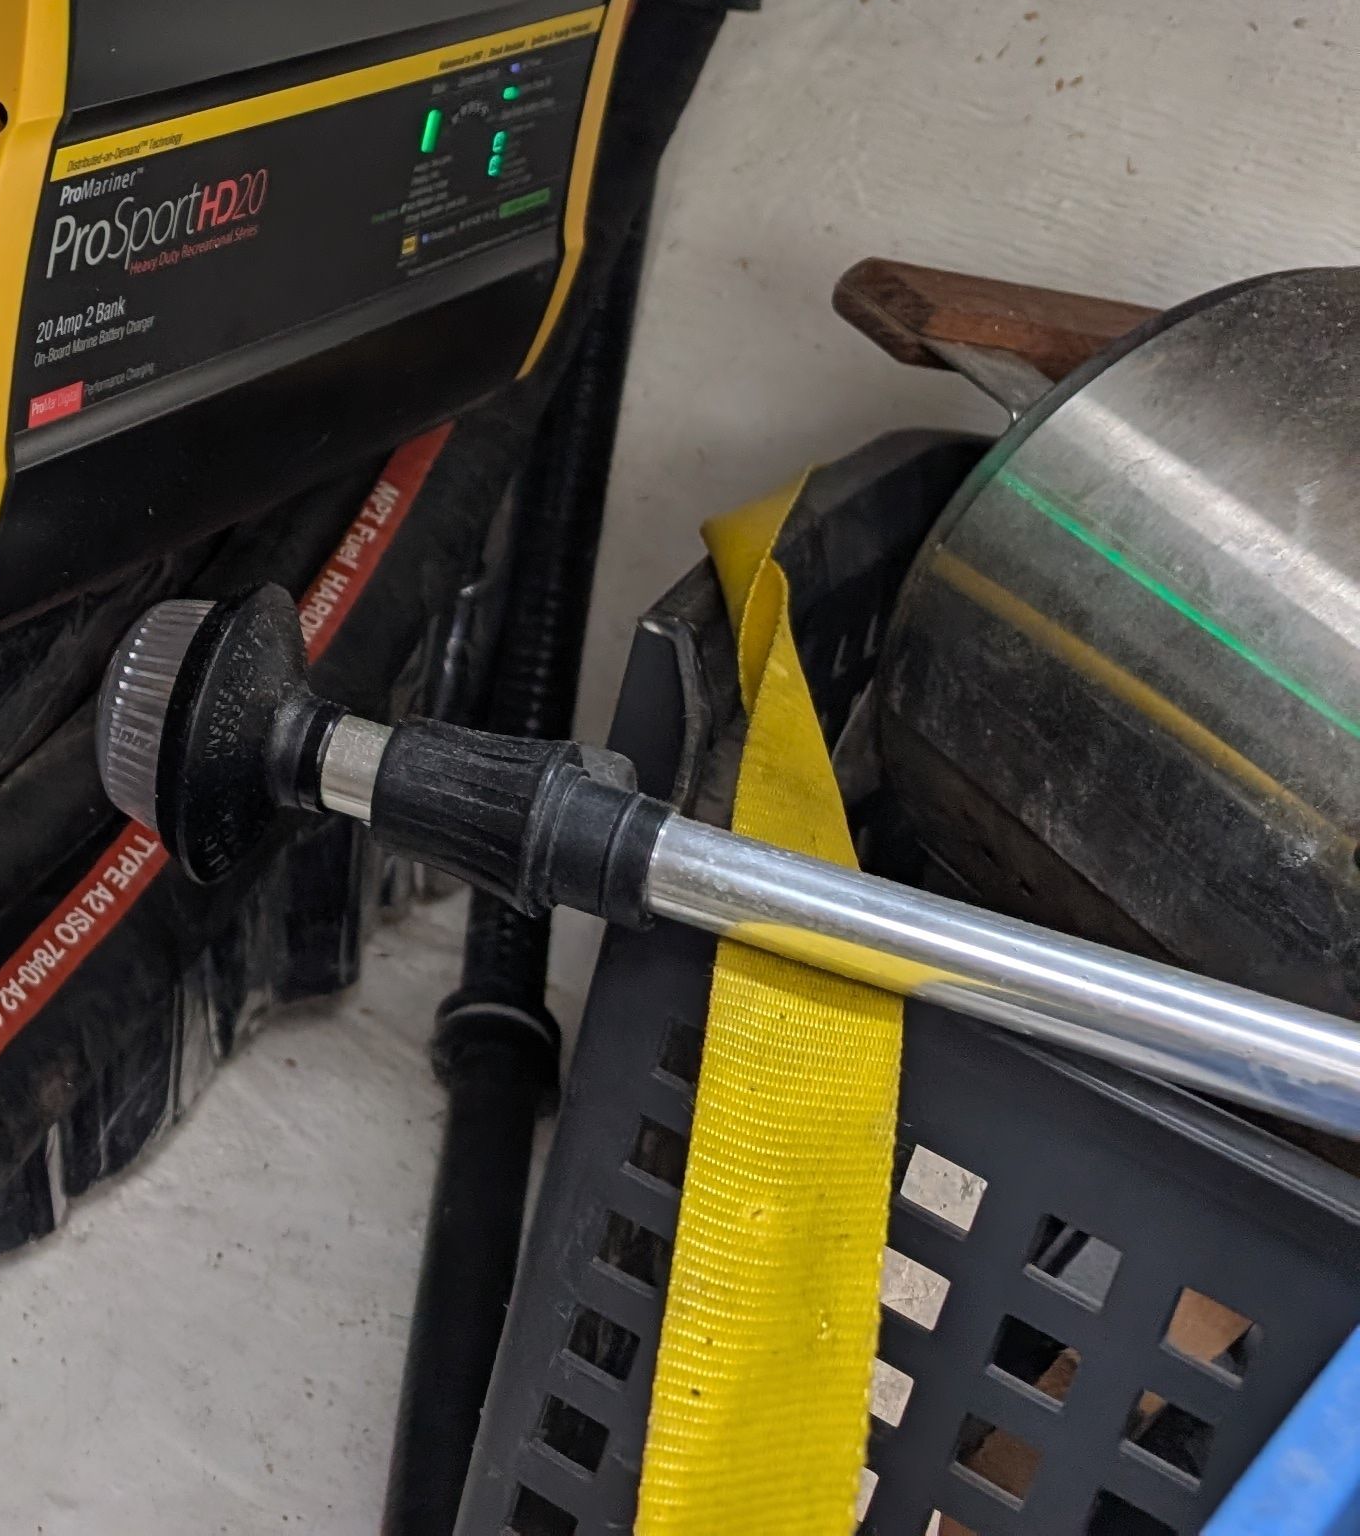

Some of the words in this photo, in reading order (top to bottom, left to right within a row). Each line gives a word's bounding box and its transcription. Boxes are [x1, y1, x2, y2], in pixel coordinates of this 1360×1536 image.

[129, 258, 157, 275] Heavy
[157, 250, 180, 266] Duty
[34, 342, 71, 368] On-Board
[72, 334, 98, 352] Marine
[99, 325, 125, 345] Battery
[126, 316, 155, 335] Charger
[36, 319, 54, 344] 20
[54, 313, 83, 339] Amp
[85, 306, 95, 327] 2
[95, 296, 127, 324] Bank
[360, 481, 400, 525] MPI
[335, 522, 377, 570] Fuel
[103, 834, 159, 890] TYPE
[81, 881, 115, 914] A2
[54, 906, 95, 944] ISO
